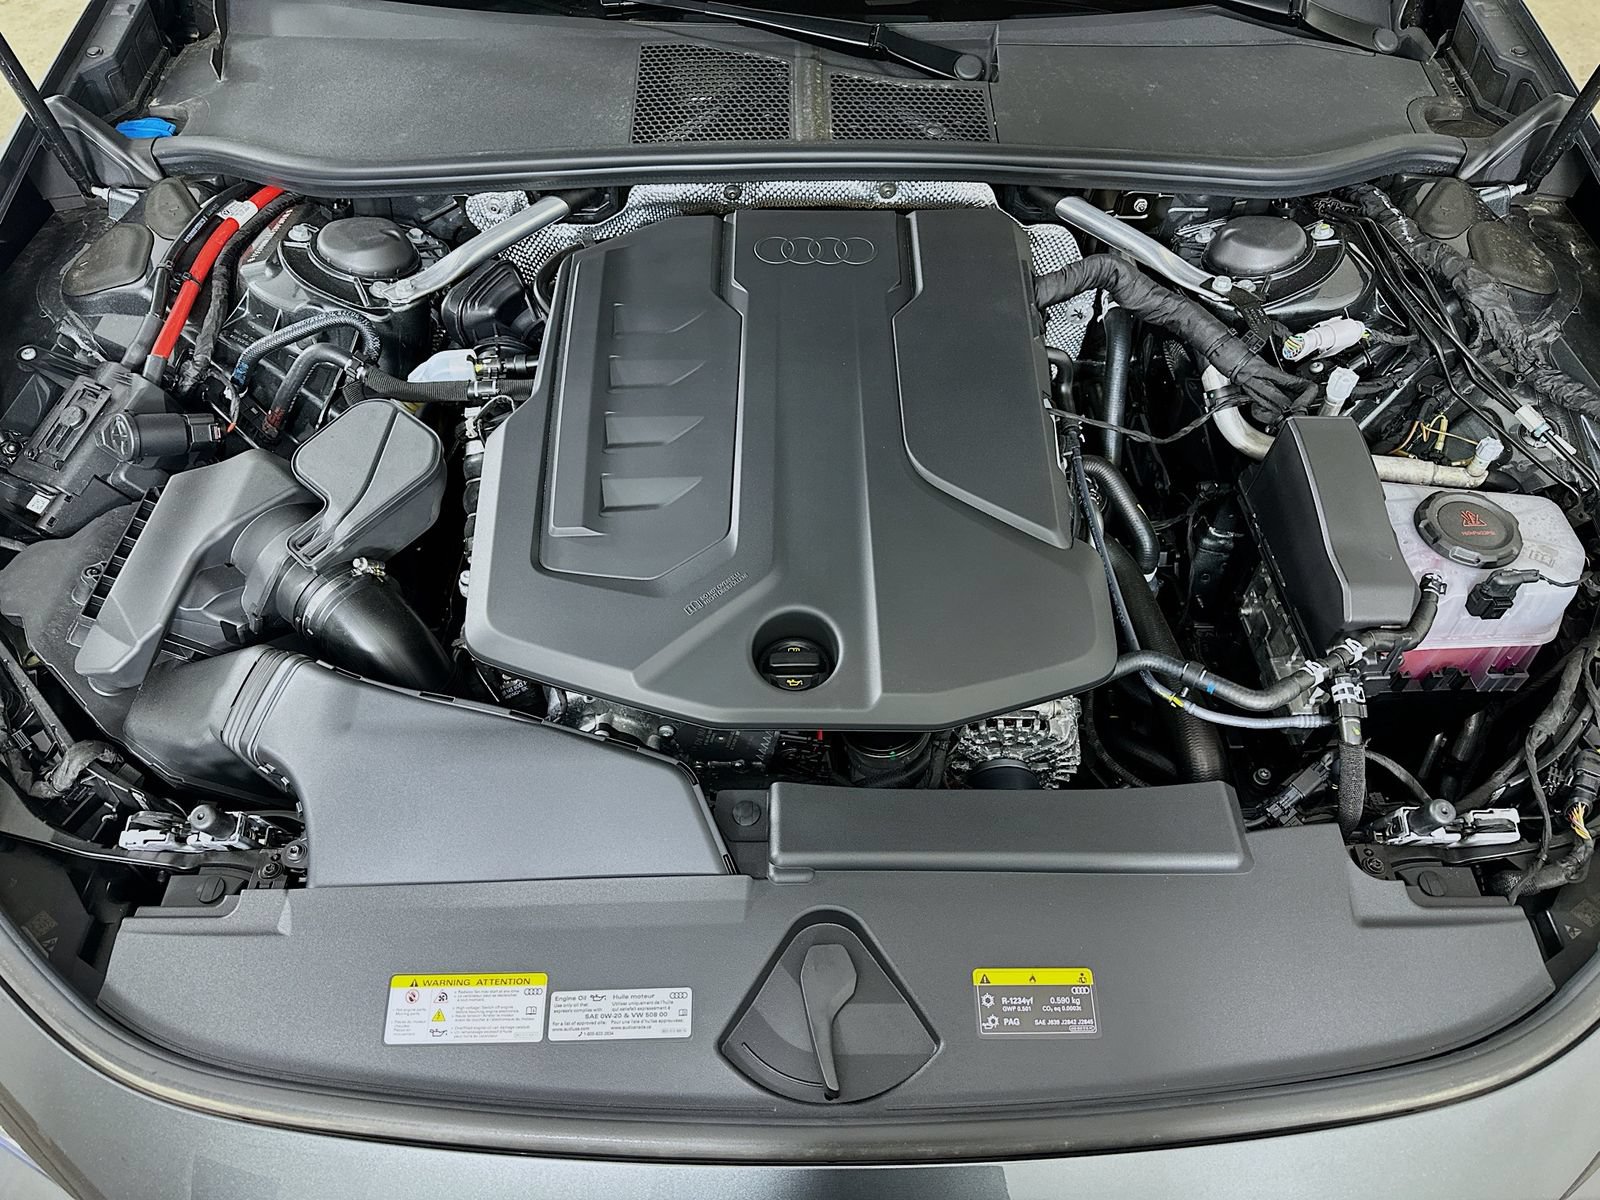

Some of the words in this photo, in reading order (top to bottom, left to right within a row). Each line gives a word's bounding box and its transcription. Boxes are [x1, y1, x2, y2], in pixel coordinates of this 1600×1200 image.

[475, 978, 531, 986] ATTENTION
[1001, 996, 1034, 1006] R-1234yf
[1050, 996, 1070, 1004] 0.590
[1071, 996, 1081, 1006] kg
[1003, 1017, 1021, 1026] PAG
